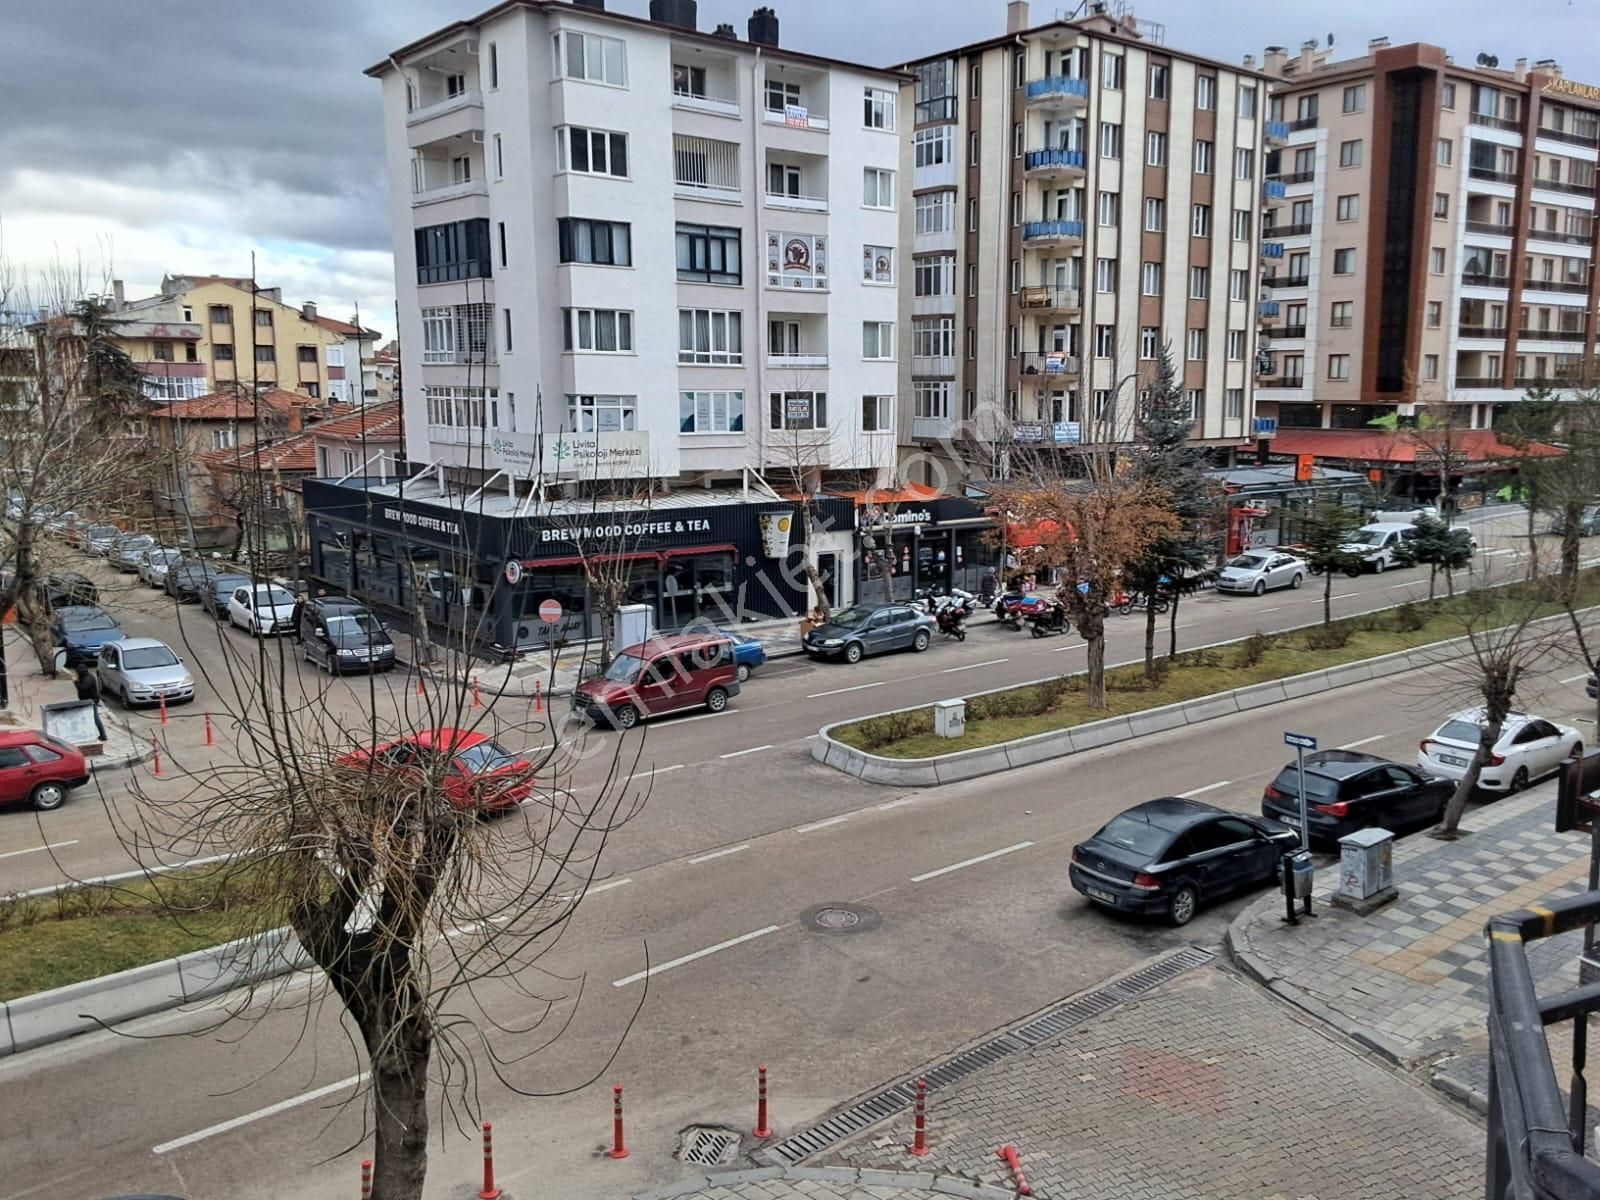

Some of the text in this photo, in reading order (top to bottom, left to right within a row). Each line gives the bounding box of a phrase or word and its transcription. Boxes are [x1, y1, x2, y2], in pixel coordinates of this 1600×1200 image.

[572, 440, 596, 449] Livita
[573, 446, 641, 460] Psikooji Merkezi
[418, 515, 440, 531] COFFEE
[542, 528, 581, 541] BREW
[624, 522, 671, 535] COFFEE
[674, 521, 684, 532] &
[687, 519, 711, 531] TEA
